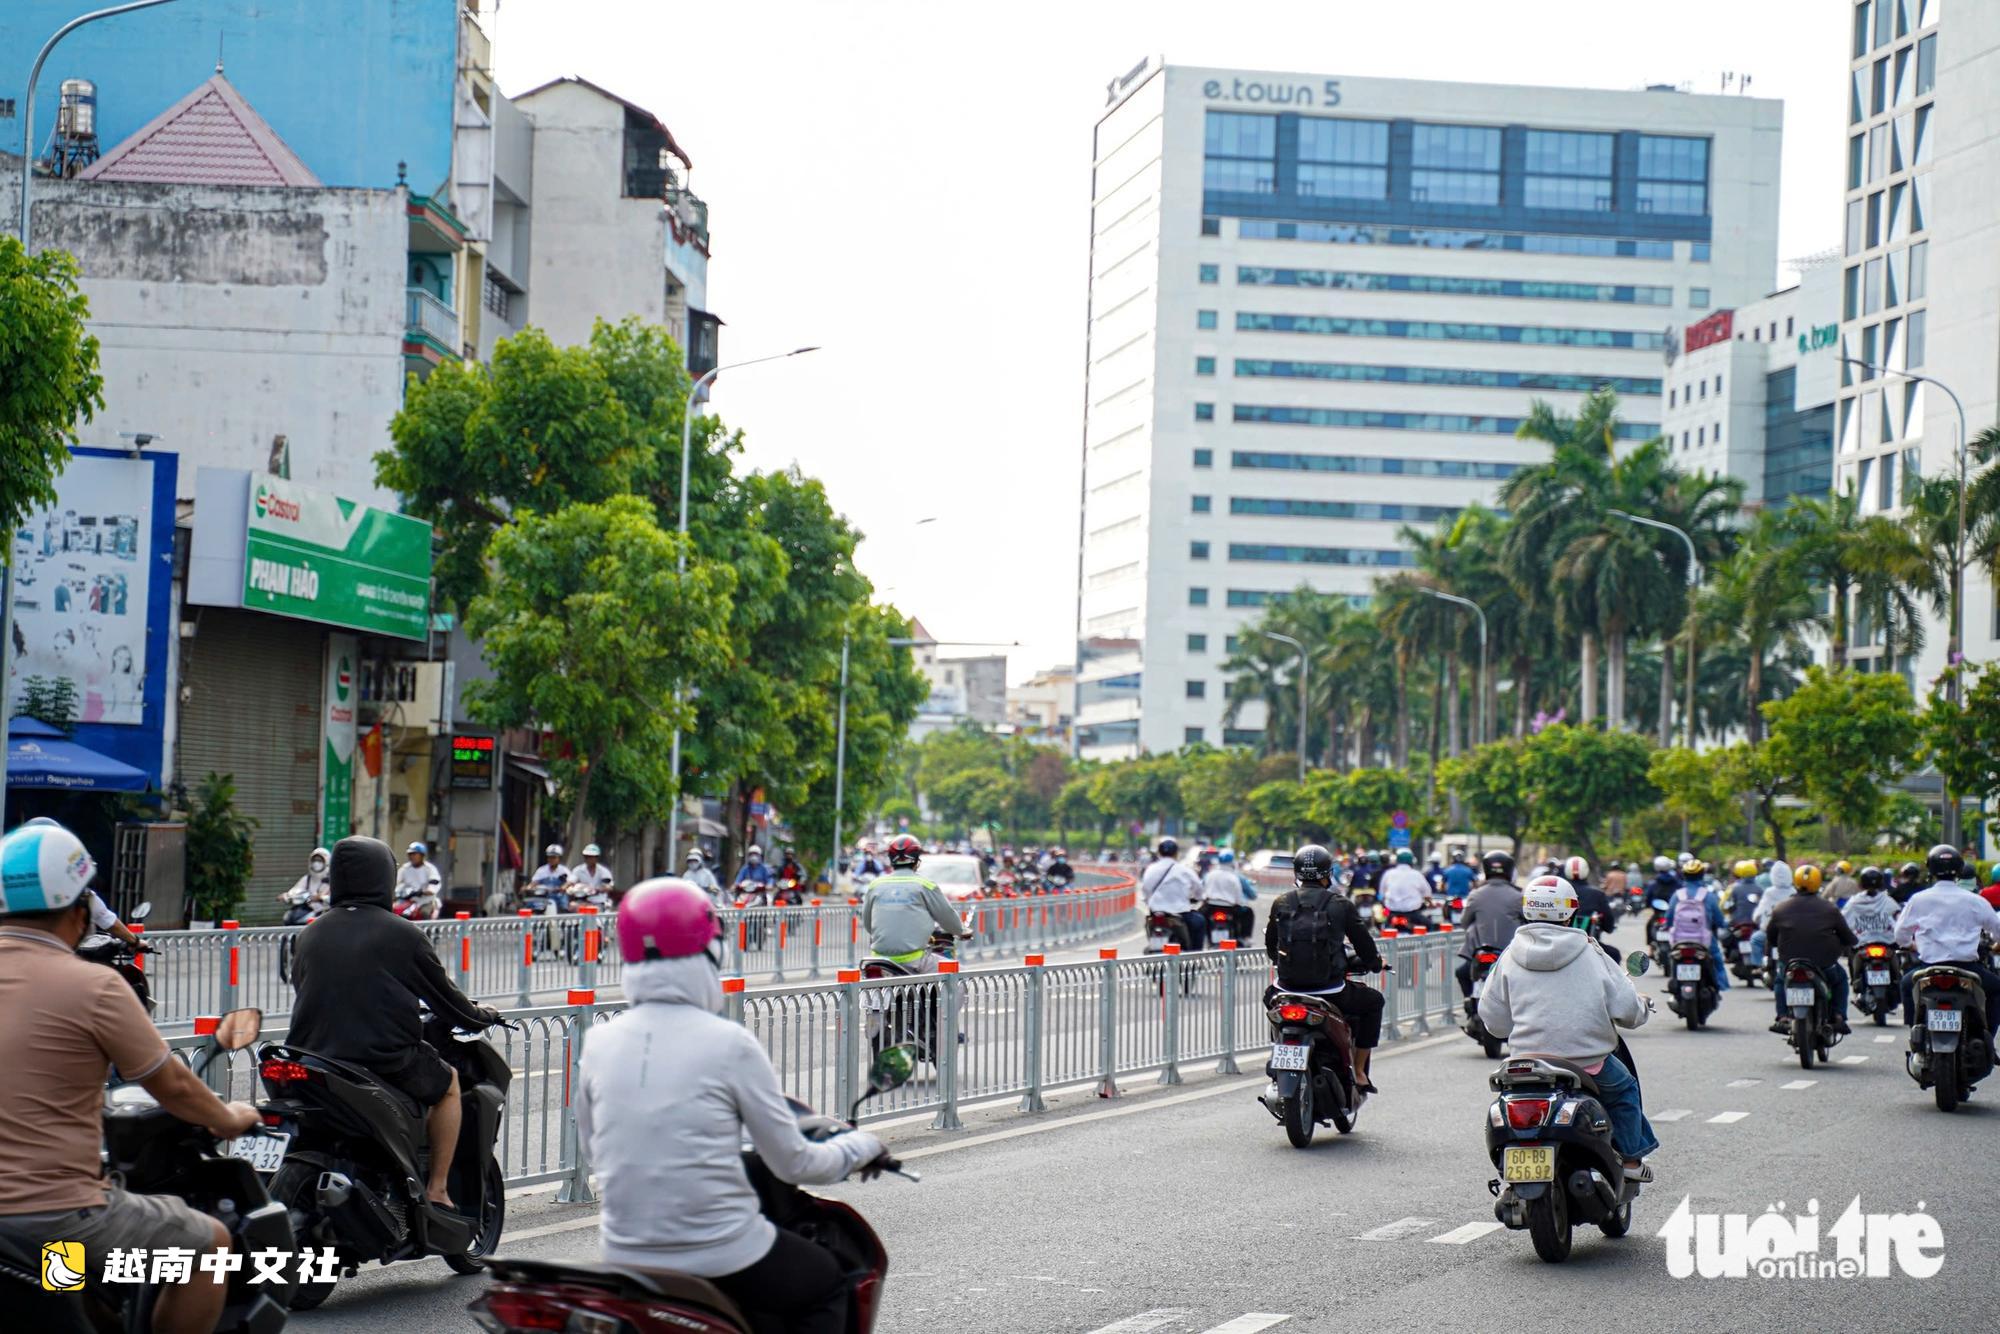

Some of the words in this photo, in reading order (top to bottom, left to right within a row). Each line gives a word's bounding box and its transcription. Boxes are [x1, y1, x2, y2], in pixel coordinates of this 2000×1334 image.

[1203, 77, 1313, 106] e.town
[1324, 80, 1342, 107] 5
[268, 493, 300, 522] Castrol
[249, 557, 290, 601] PHẠM
[1526, 900, 1555, 908] HDBank
[1277, 1046, 1303, 1057] 59-GA
[1274, 1057, 1305, 1069] 206.52
[1512, 1150, 1546, 1164] 60-B9
[1507, 1165, 1551, 1180] 256.92
